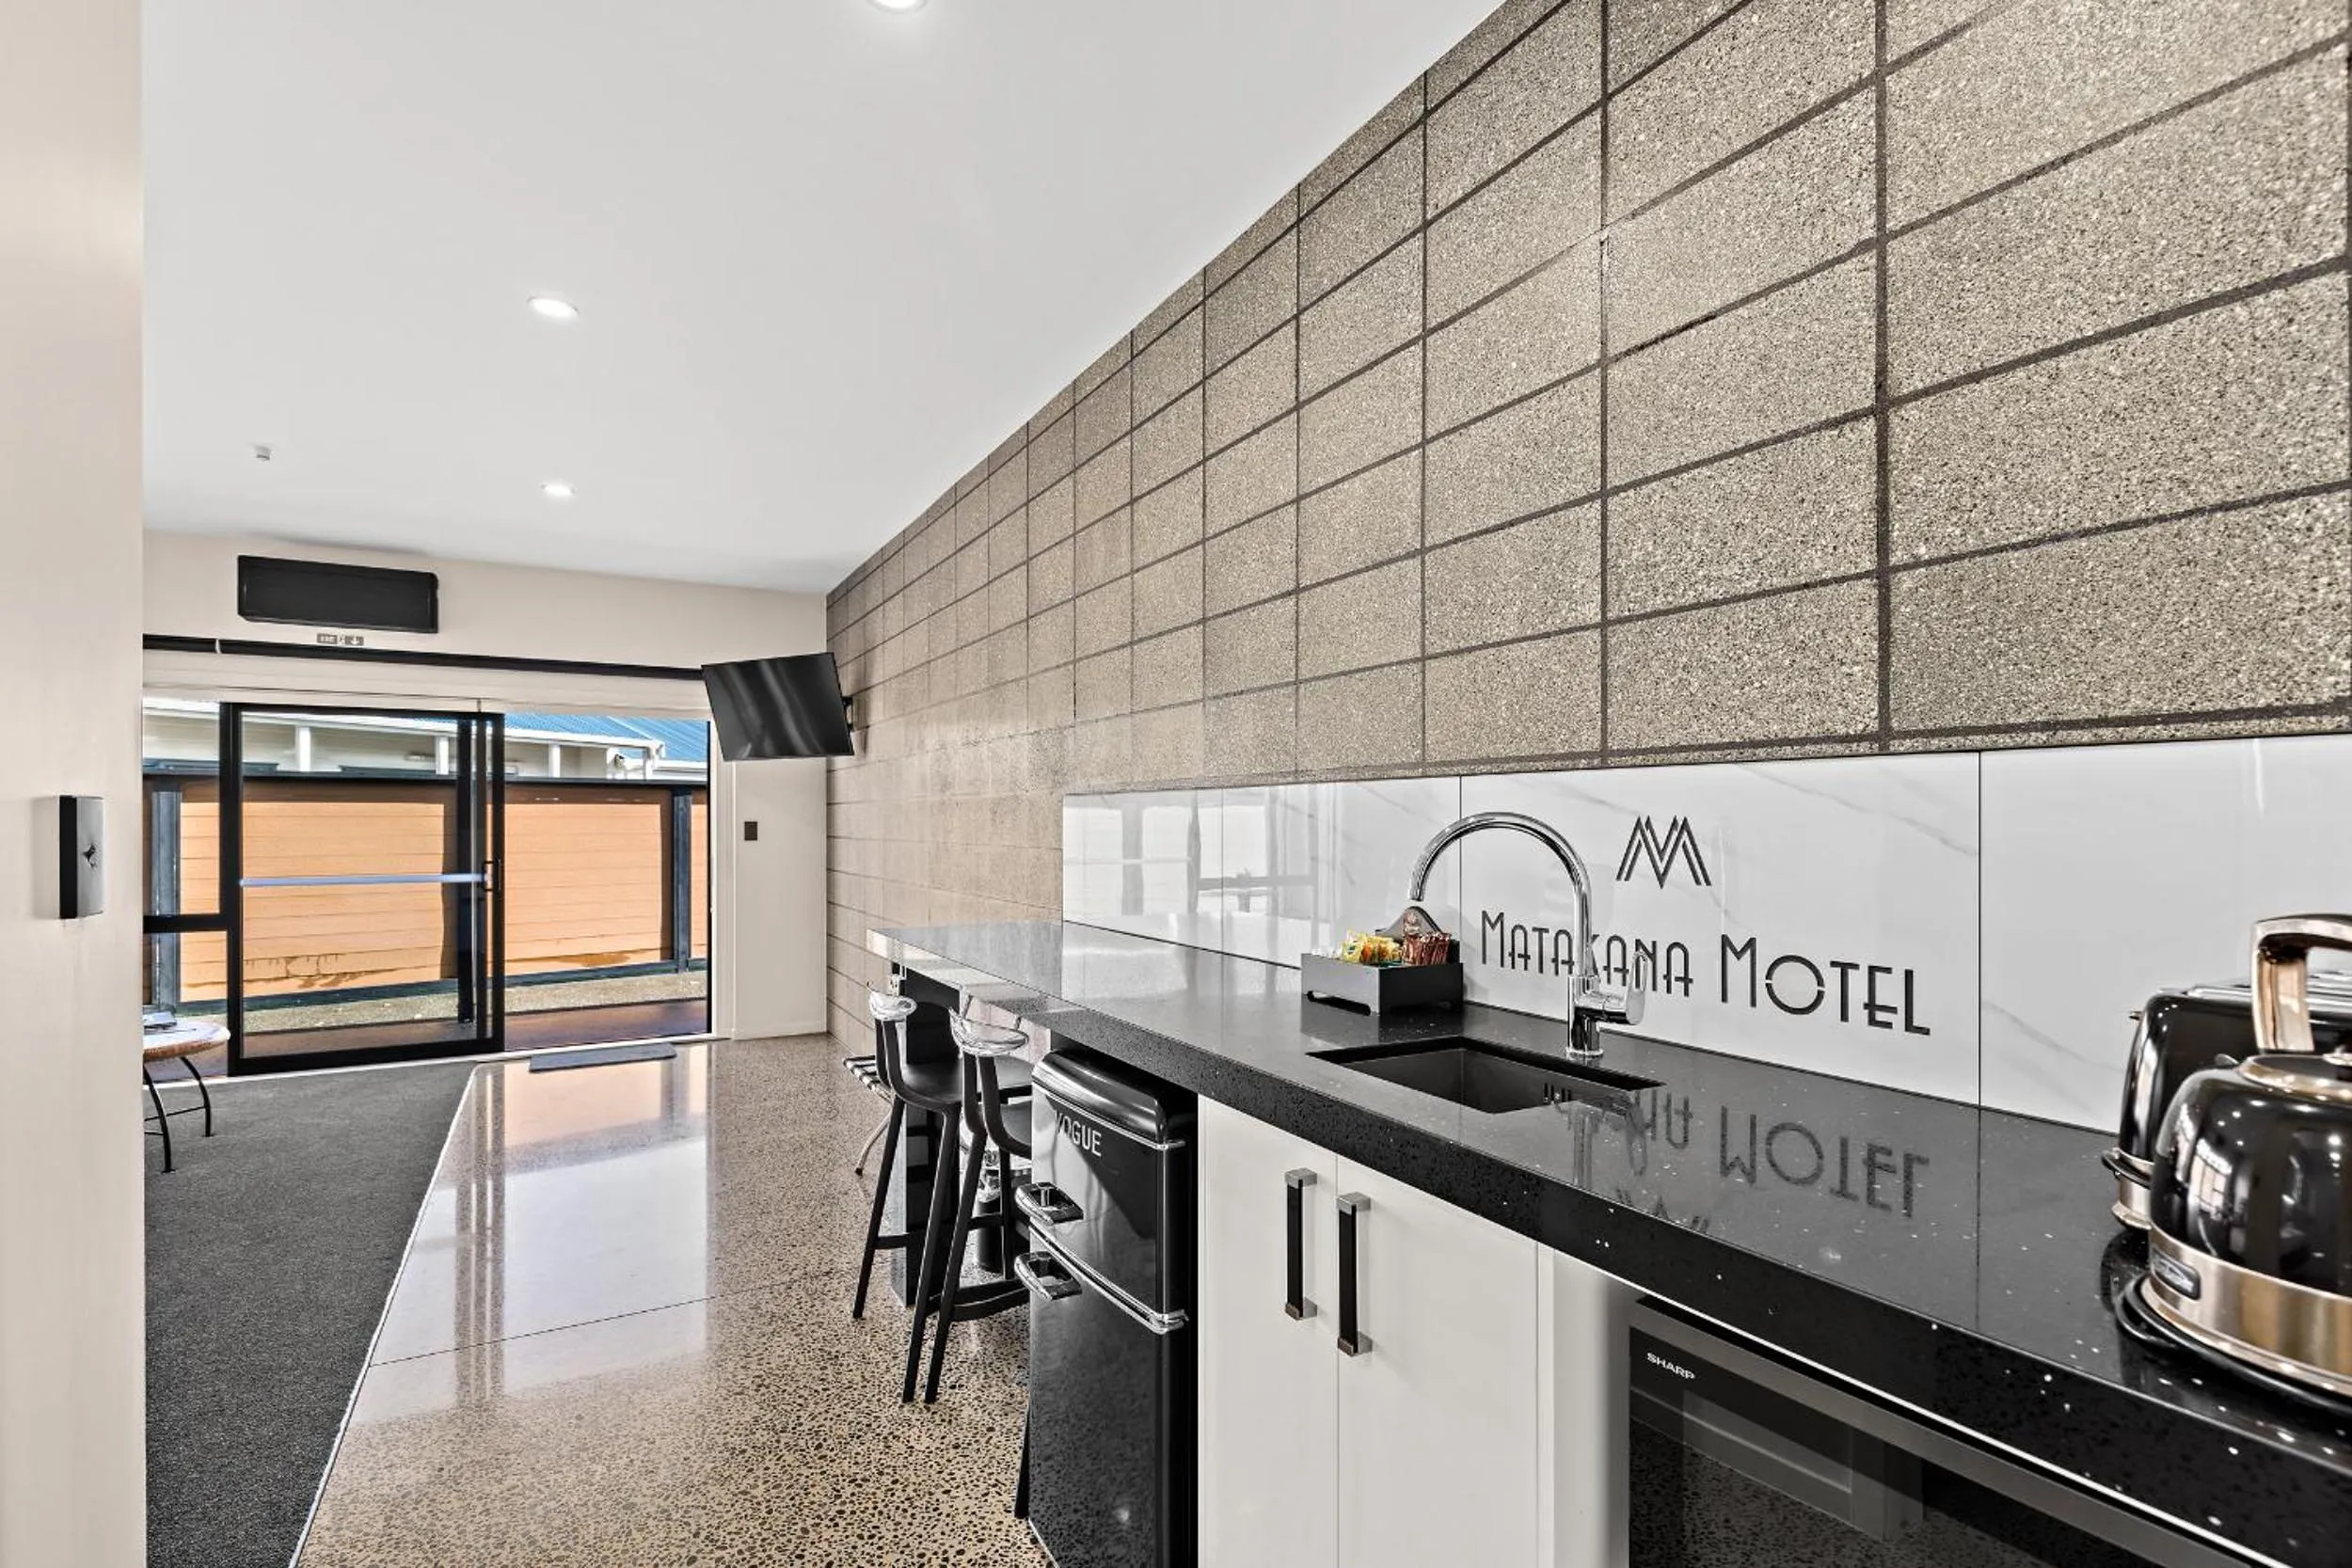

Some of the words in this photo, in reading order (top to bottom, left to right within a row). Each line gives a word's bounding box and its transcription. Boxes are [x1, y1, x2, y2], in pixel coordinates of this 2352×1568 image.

[1721, 934, 1930, 1036] MOTEL
[1054, 1110, 1102, 1157] VOGUE
[1646, 1353, 1695, 1379] SHARP
